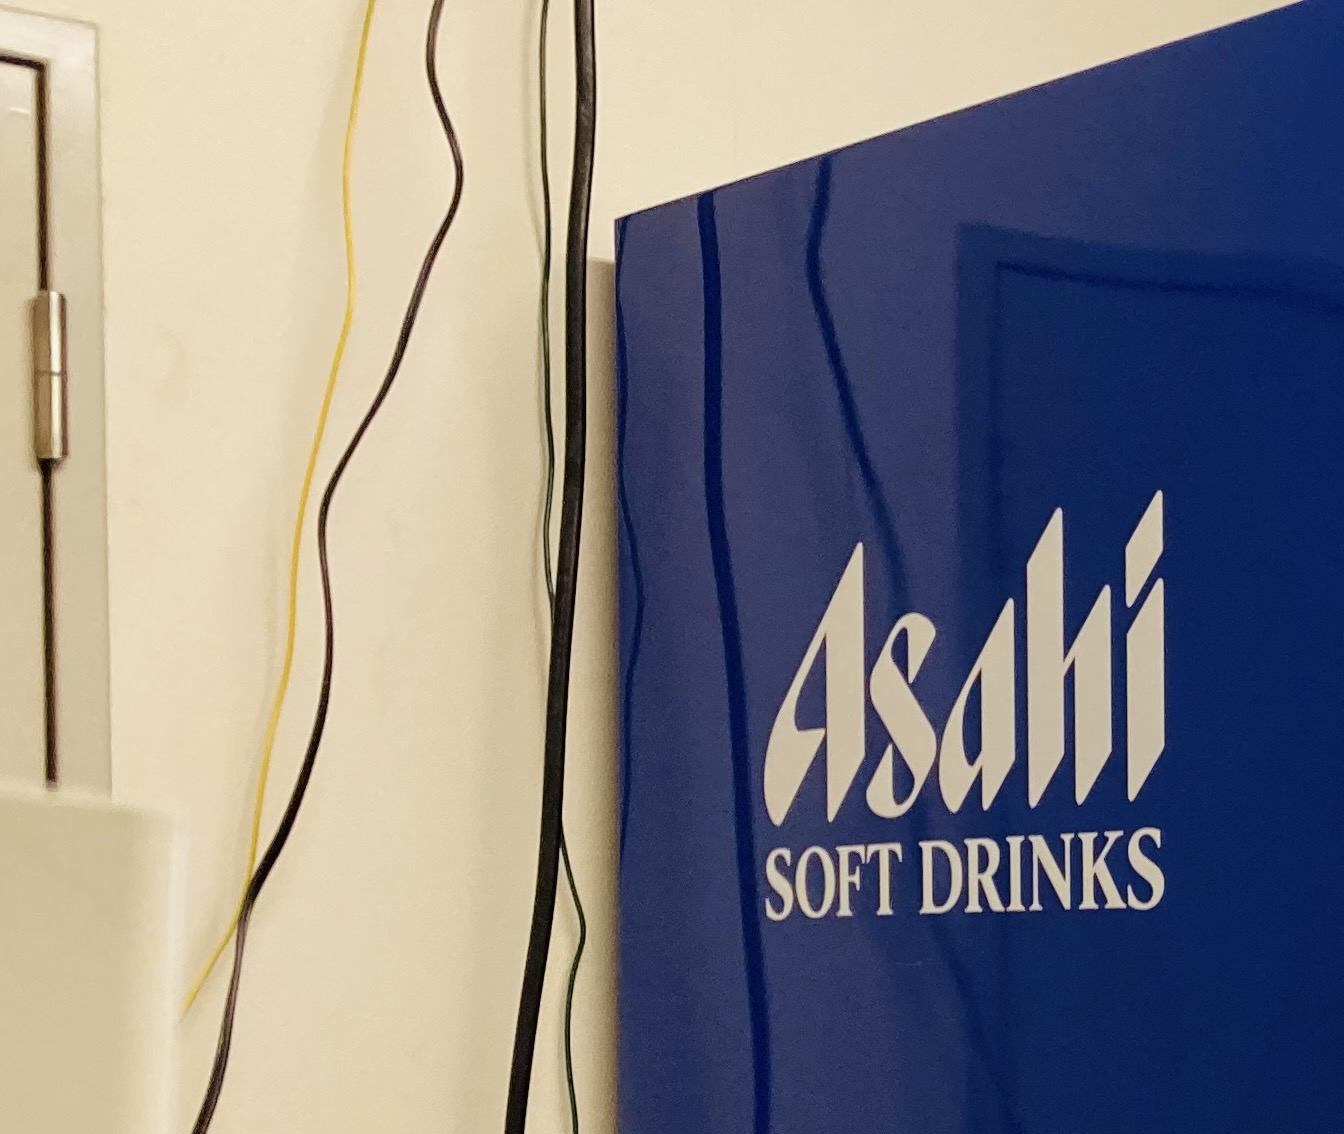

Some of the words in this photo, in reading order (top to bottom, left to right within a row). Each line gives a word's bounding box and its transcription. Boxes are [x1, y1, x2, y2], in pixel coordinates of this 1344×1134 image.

[764, 490, 1165, 827] Asahi
[765, 843, 902, 921] SOFT
[919, 827, 1165, 915] DRINKS
